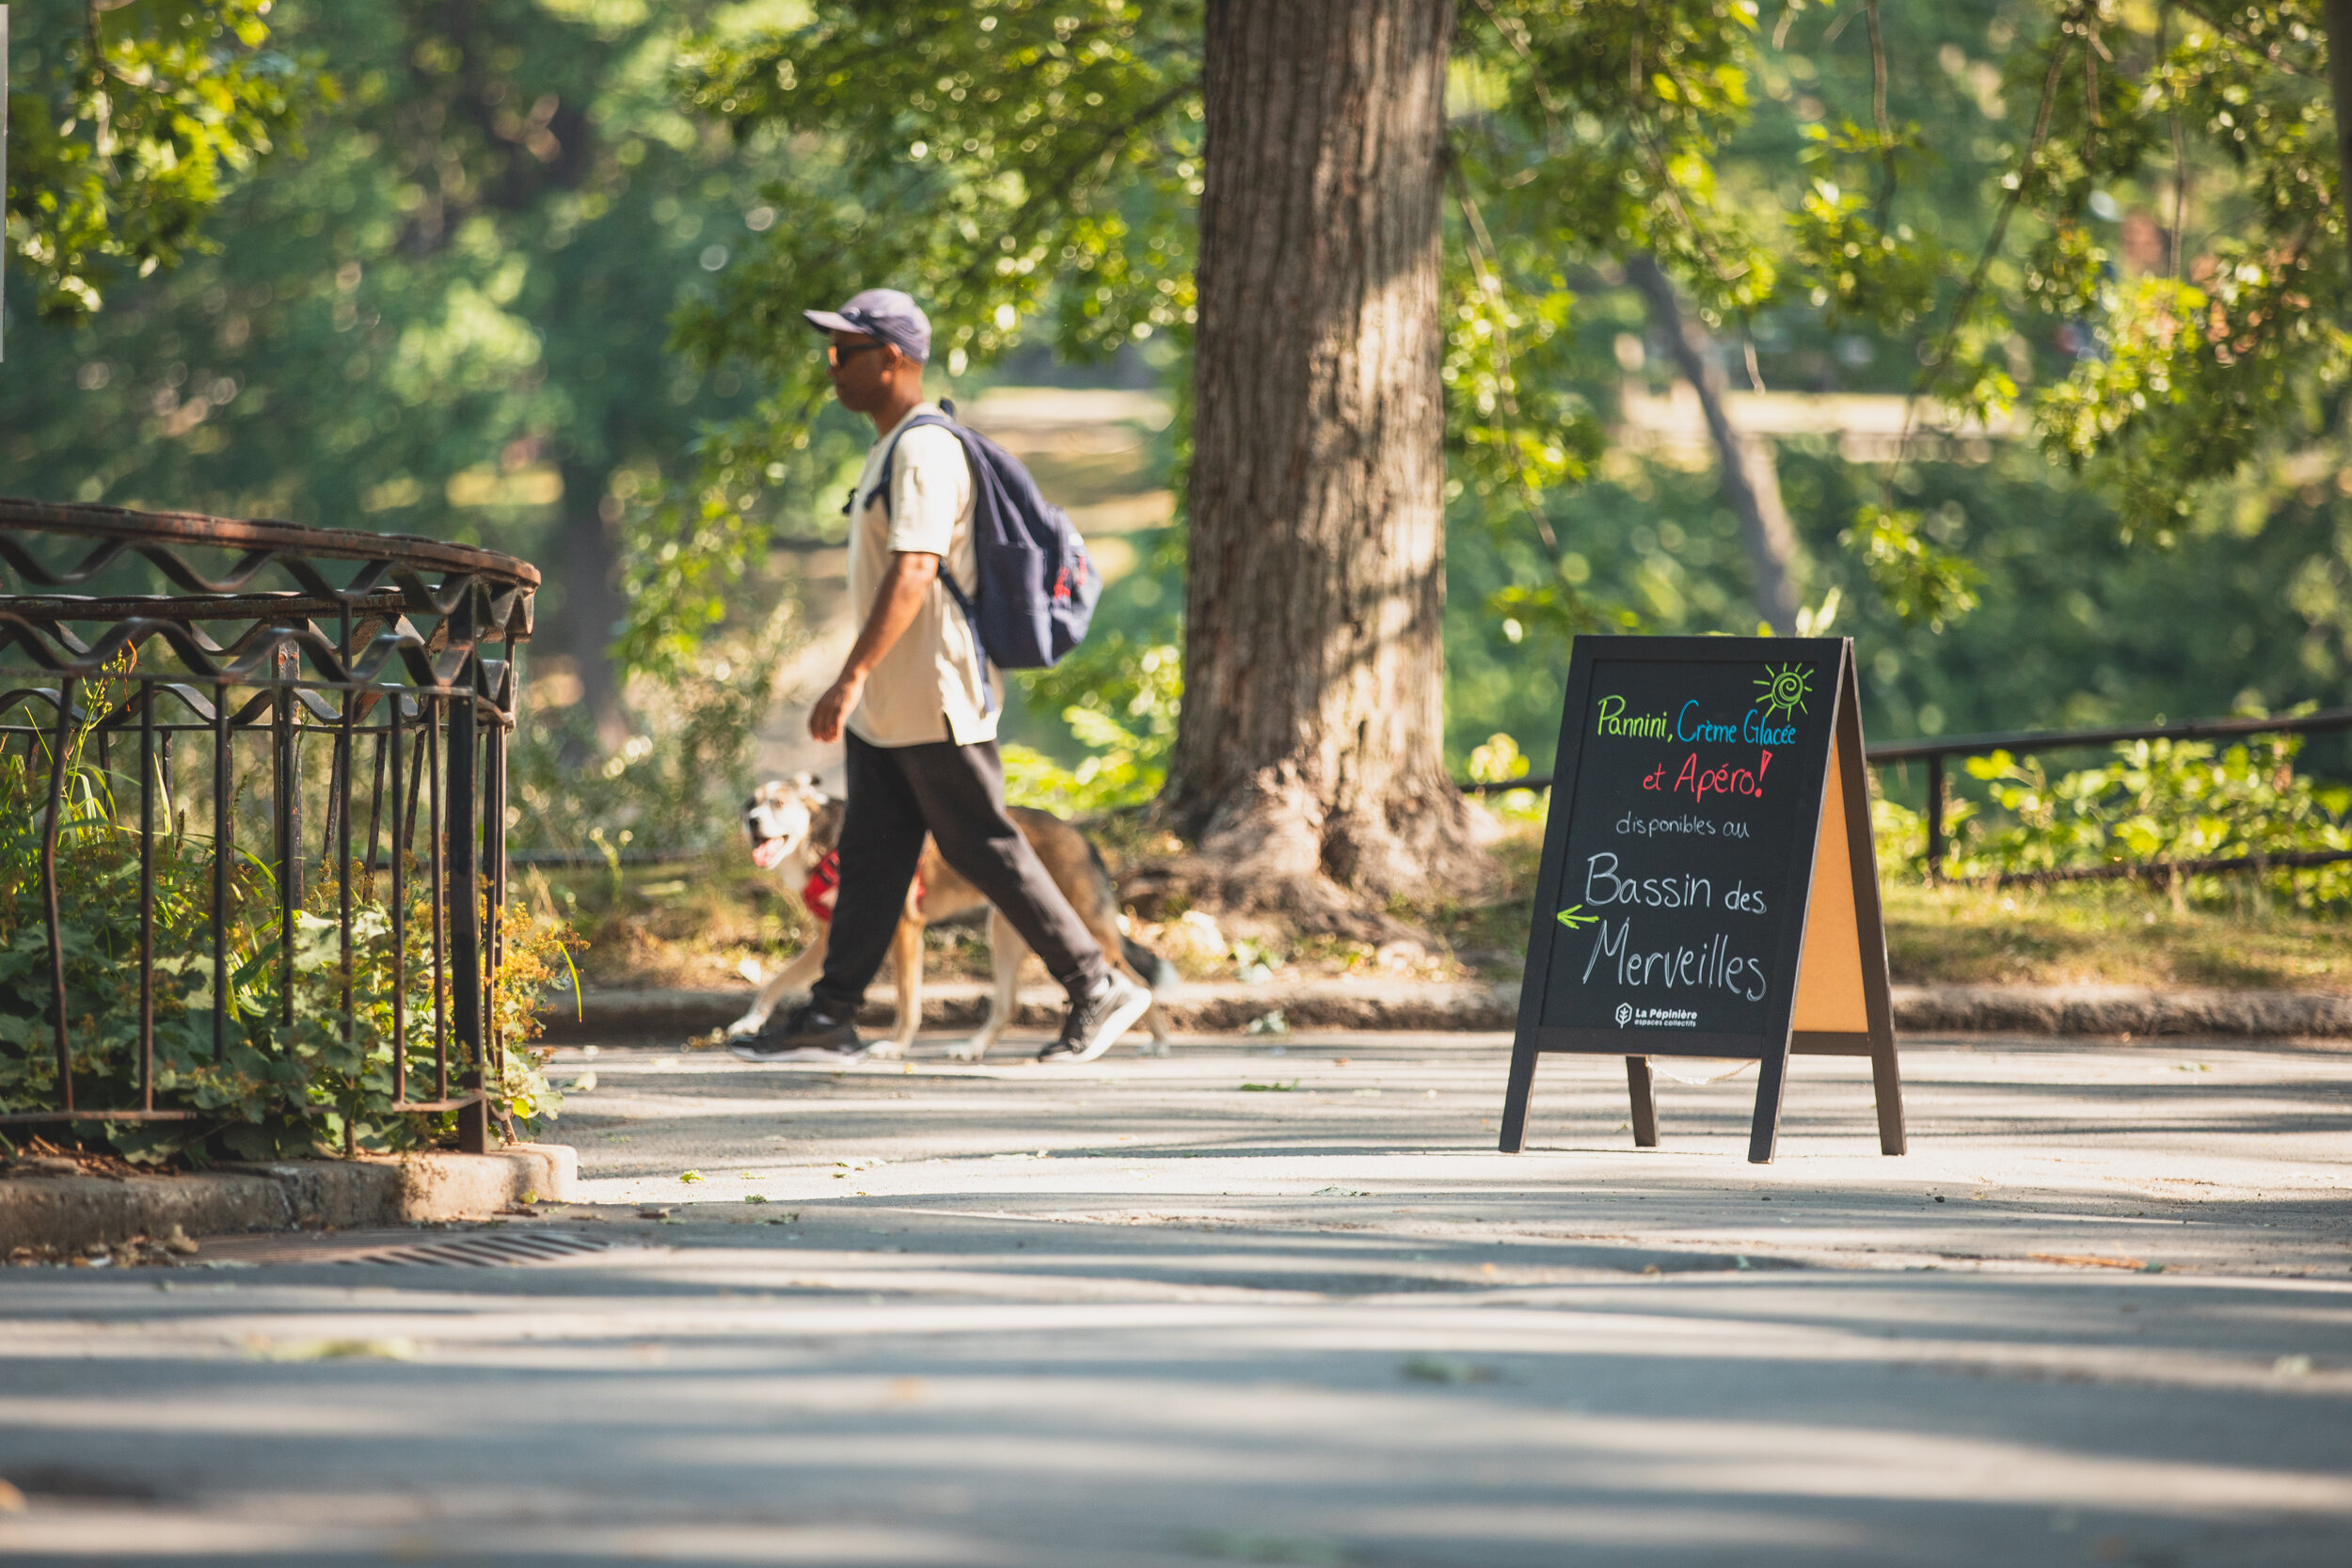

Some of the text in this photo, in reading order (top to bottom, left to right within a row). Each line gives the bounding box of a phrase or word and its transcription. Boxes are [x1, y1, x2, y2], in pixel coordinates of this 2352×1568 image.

[1597, 694, 1796, 746] Pannini, Crème Glacée
[1643, 749, 1773, 803] et Apéro!
[1615, 810, 1750, 839] disponibles au
[1585, 851, 1767, 914] Bassin des
[1582, 916, 1767, 1003] Merveilles
[1634, 1019, 1697, 1028] espaces collectifs
[1635, 1007, 1698, 1021] La Pépinière
